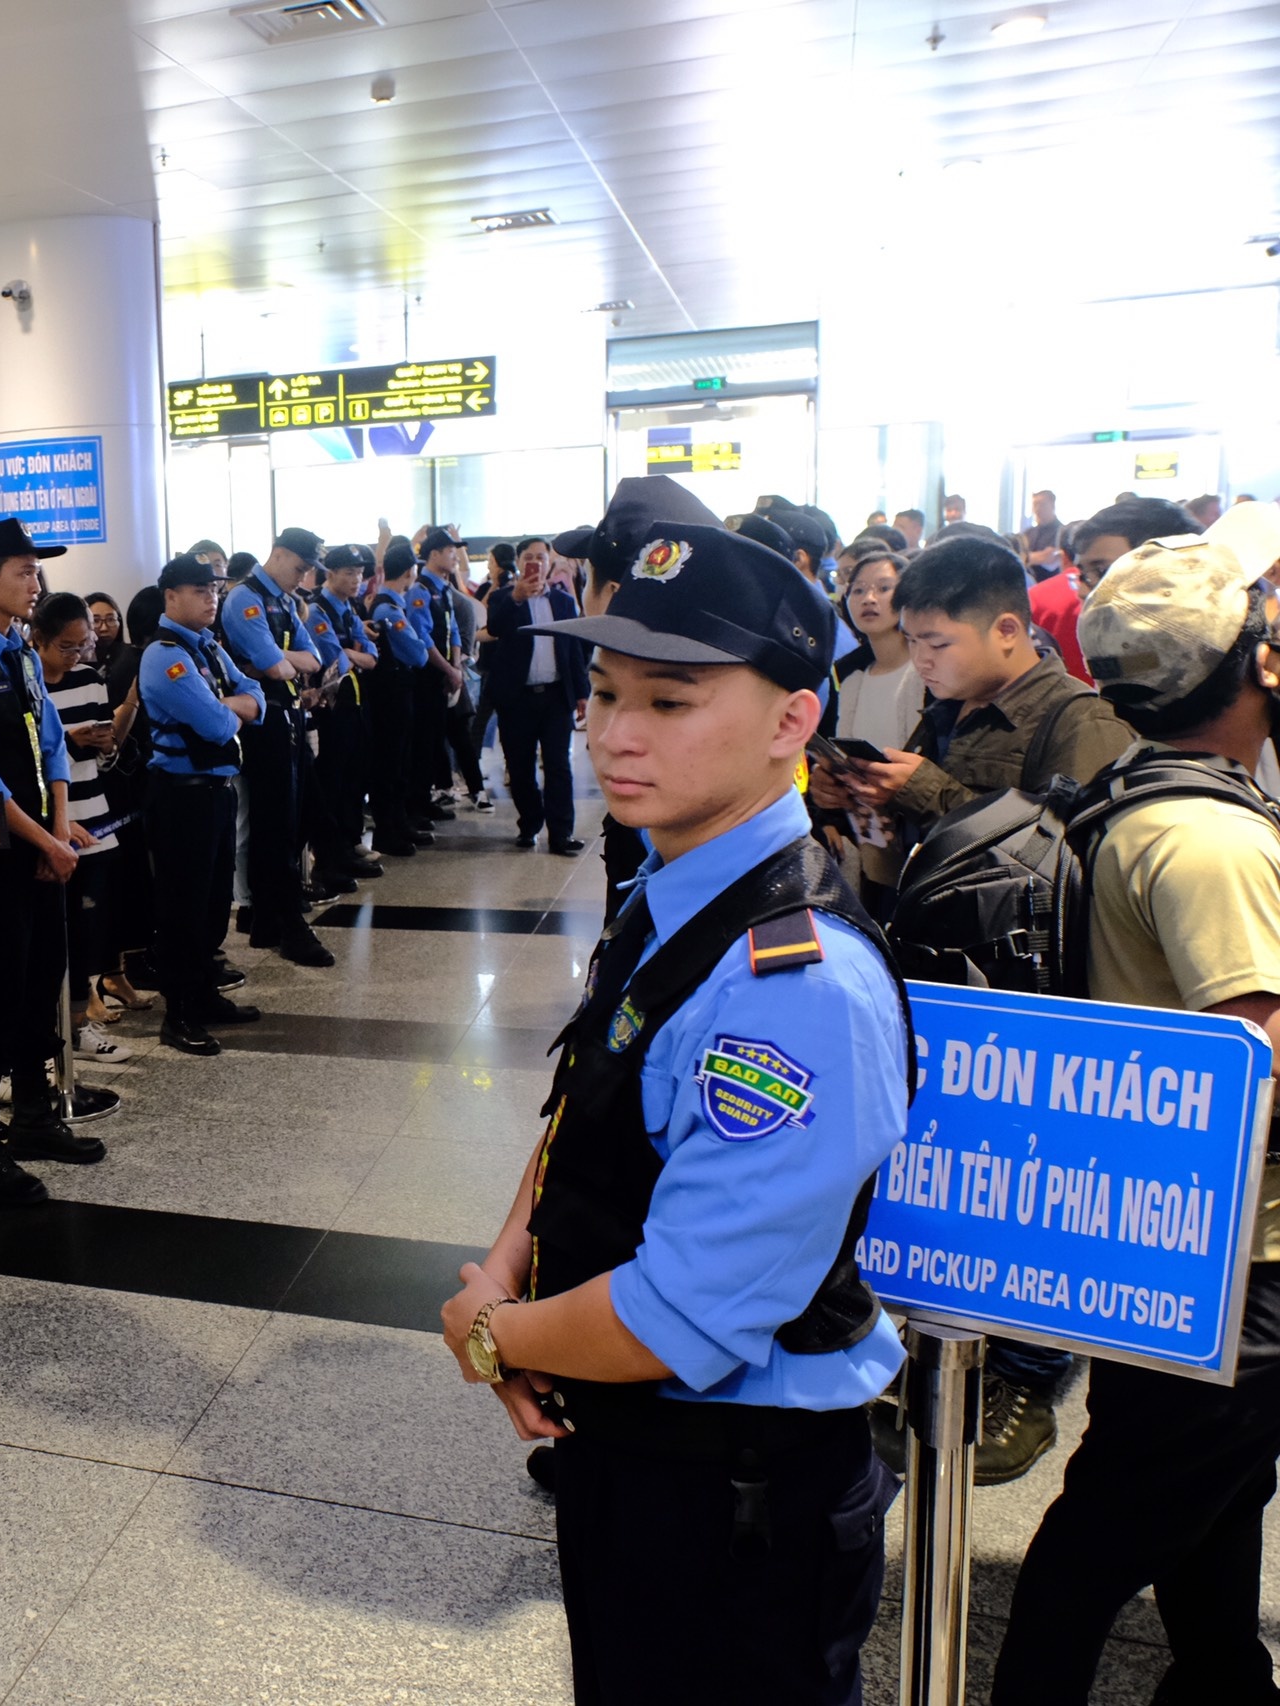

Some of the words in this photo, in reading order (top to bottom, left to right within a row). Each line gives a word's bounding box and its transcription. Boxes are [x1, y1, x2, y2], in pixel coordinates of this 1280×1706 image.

[27, 451, 51, 474] ĐÓN
[53, 449, 93, 472] KHÁCH
[713, 1058, 761, 1085] BAO
[941, 1032, 1037, 1107] ĐÓN
[1049, 1050, 1214, 1132] KHÁCH
[714, 1087, 774, 1120] SECURITY
[718, 1102, 759, 1127] GUARD
[886, 1119, 953, 1211] BIỂN
[959, 1140, 1012, 1221] TÊN
[1016, 1133, 1041, 1226] Ở
[1042, 1157, 1111, 1239] PHÍA
[1118, 1172, 1215, 1257] NGOÀI
[906, 1244, 998, 1293] PICKUP
[1001, 1263, 1071, 1311] AREA
[1078, 1278, 1196, 1335] OUTSIDE
